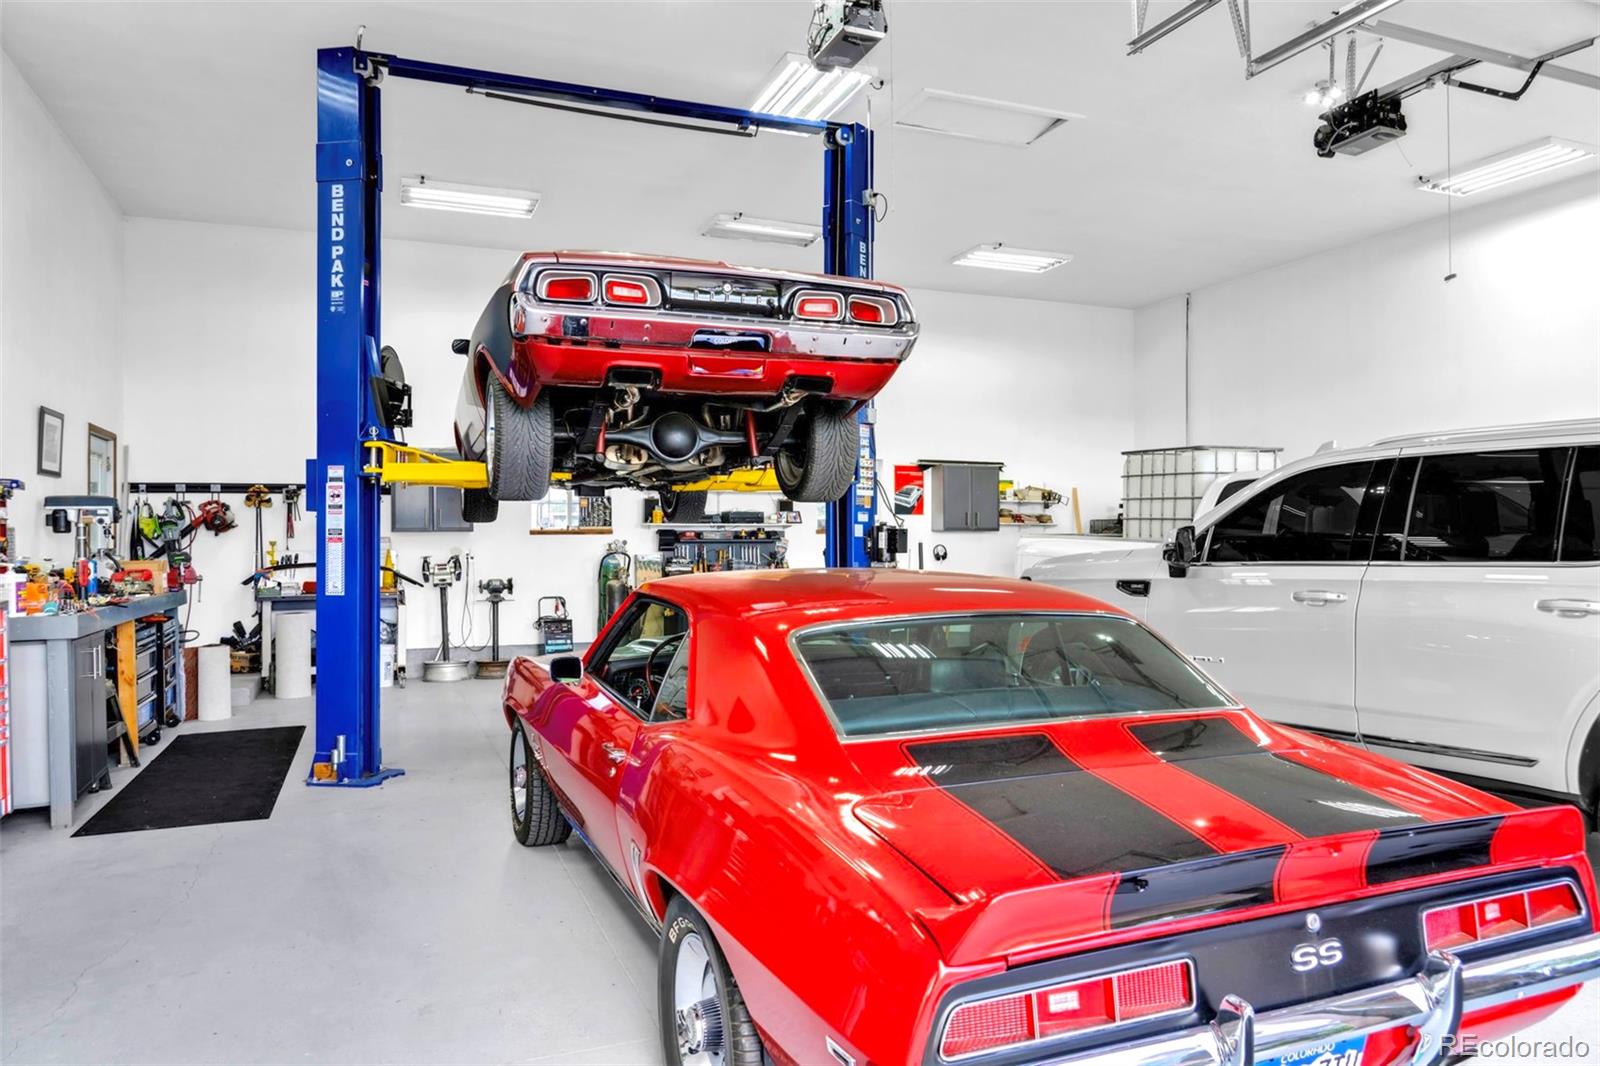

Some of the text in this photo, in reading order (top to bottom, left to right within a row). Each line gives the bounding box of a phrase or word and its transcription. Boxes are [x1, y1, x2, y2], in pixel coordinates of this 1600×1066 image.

[331, 184, 344, 241] BEND
[331, 246, 344, 287] PAK
[1292, 938, 1343, 972] SS
[1281, 1042, 1336, 1063] COLORADO
